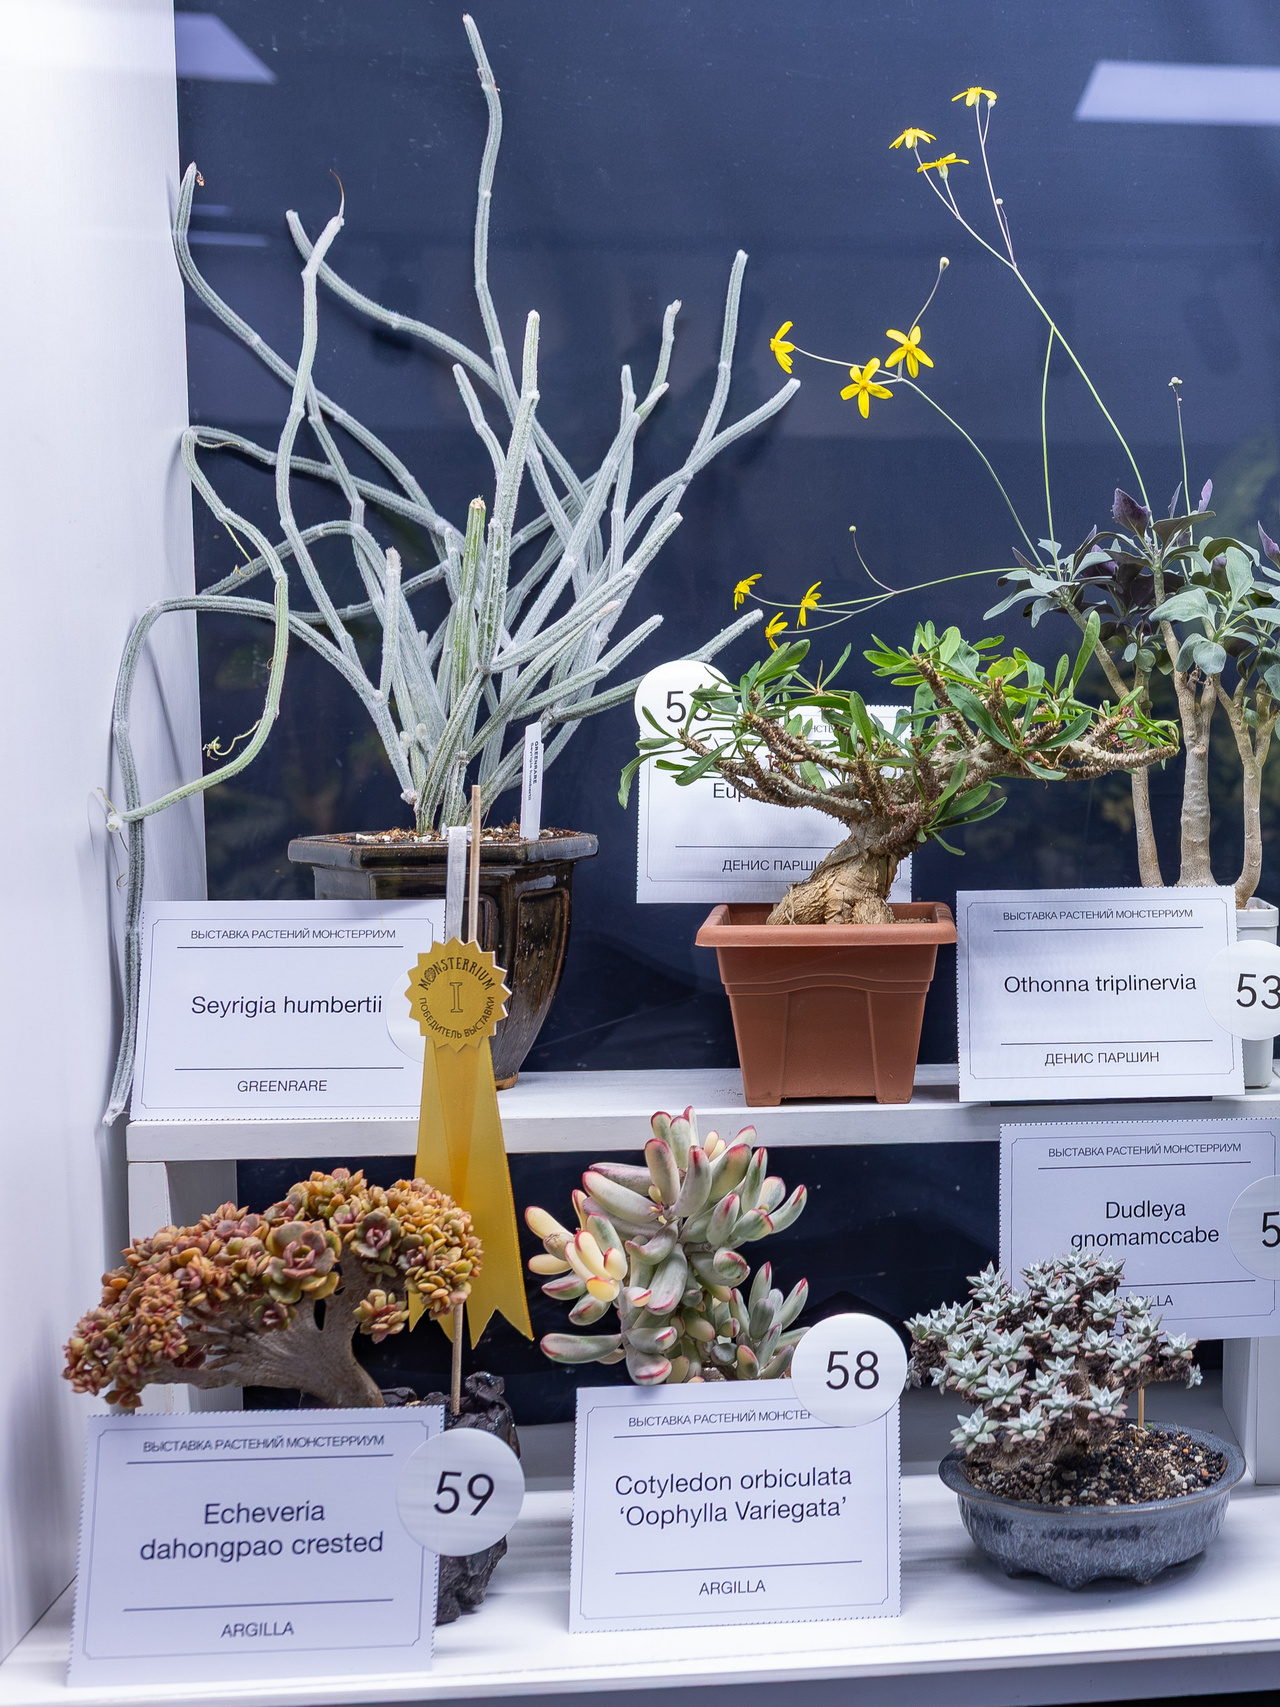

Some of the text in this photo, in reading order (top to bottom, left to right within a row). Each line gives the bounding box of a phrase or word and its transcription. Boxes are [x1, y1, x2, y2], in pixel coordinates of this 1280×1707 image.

[722, 859, 823, 872] ДЕНИС ПАРШ
[1003, 908, 1193, 921] ВЫСТАВКА РАСТЕНИЙ МОНСТЕРРИУМ
[191, 927, 396, 940] ВЫСТАВКА РАСТЕНИЙ МОНСТЕРРИУМ
[418, 957, 495, 991] MONSTERRIUM
[1004, 973, 1197, 996] Othonna triplinervia
[191, 995, 382, 1018] Seyrigia humbertii
[419, 996, 495, 1039] ПОБЕДИТЕЛЬ ВЫСТАВКИ
[1044, 1051, 1160, 1067] ДЕНИС ПАРШИН
[237, 1080, 327, 1093] GREENRARE
[1048, 1143, 1241, 1158] ВЫСТАВКА РАСТЕНИЙ МОНСТЕРРИУМ
[1105, 1200, 1186, 1222] Dudleya
[1070, 1225, 1220, 1251] gnomamccabe
[825, 1351, 880, 1390] 58
[628, 1409, 811, 1427] ВЫСТАВКА РАСТЕНИЙ МОНСТЕ
[143, 1435, 385, 1453] ВЫСТАВКА РАСТЕНИЙ МОНСТЕРРИУМ
[433, 1471, 495, 1516] 59
[615, 1467, 852, 1498] Cotyledon orbiculata
[204, 1500, 325, 1525] Echeveria
[620, 1497, 847, 1530] ‘Oophylla Variegata’
[140, 1531, 384, 1564] dahongpao crested
[699, 1579, 766, 1596] ARGILLA
[220, 1621, 294, 1638] ARGILLA
